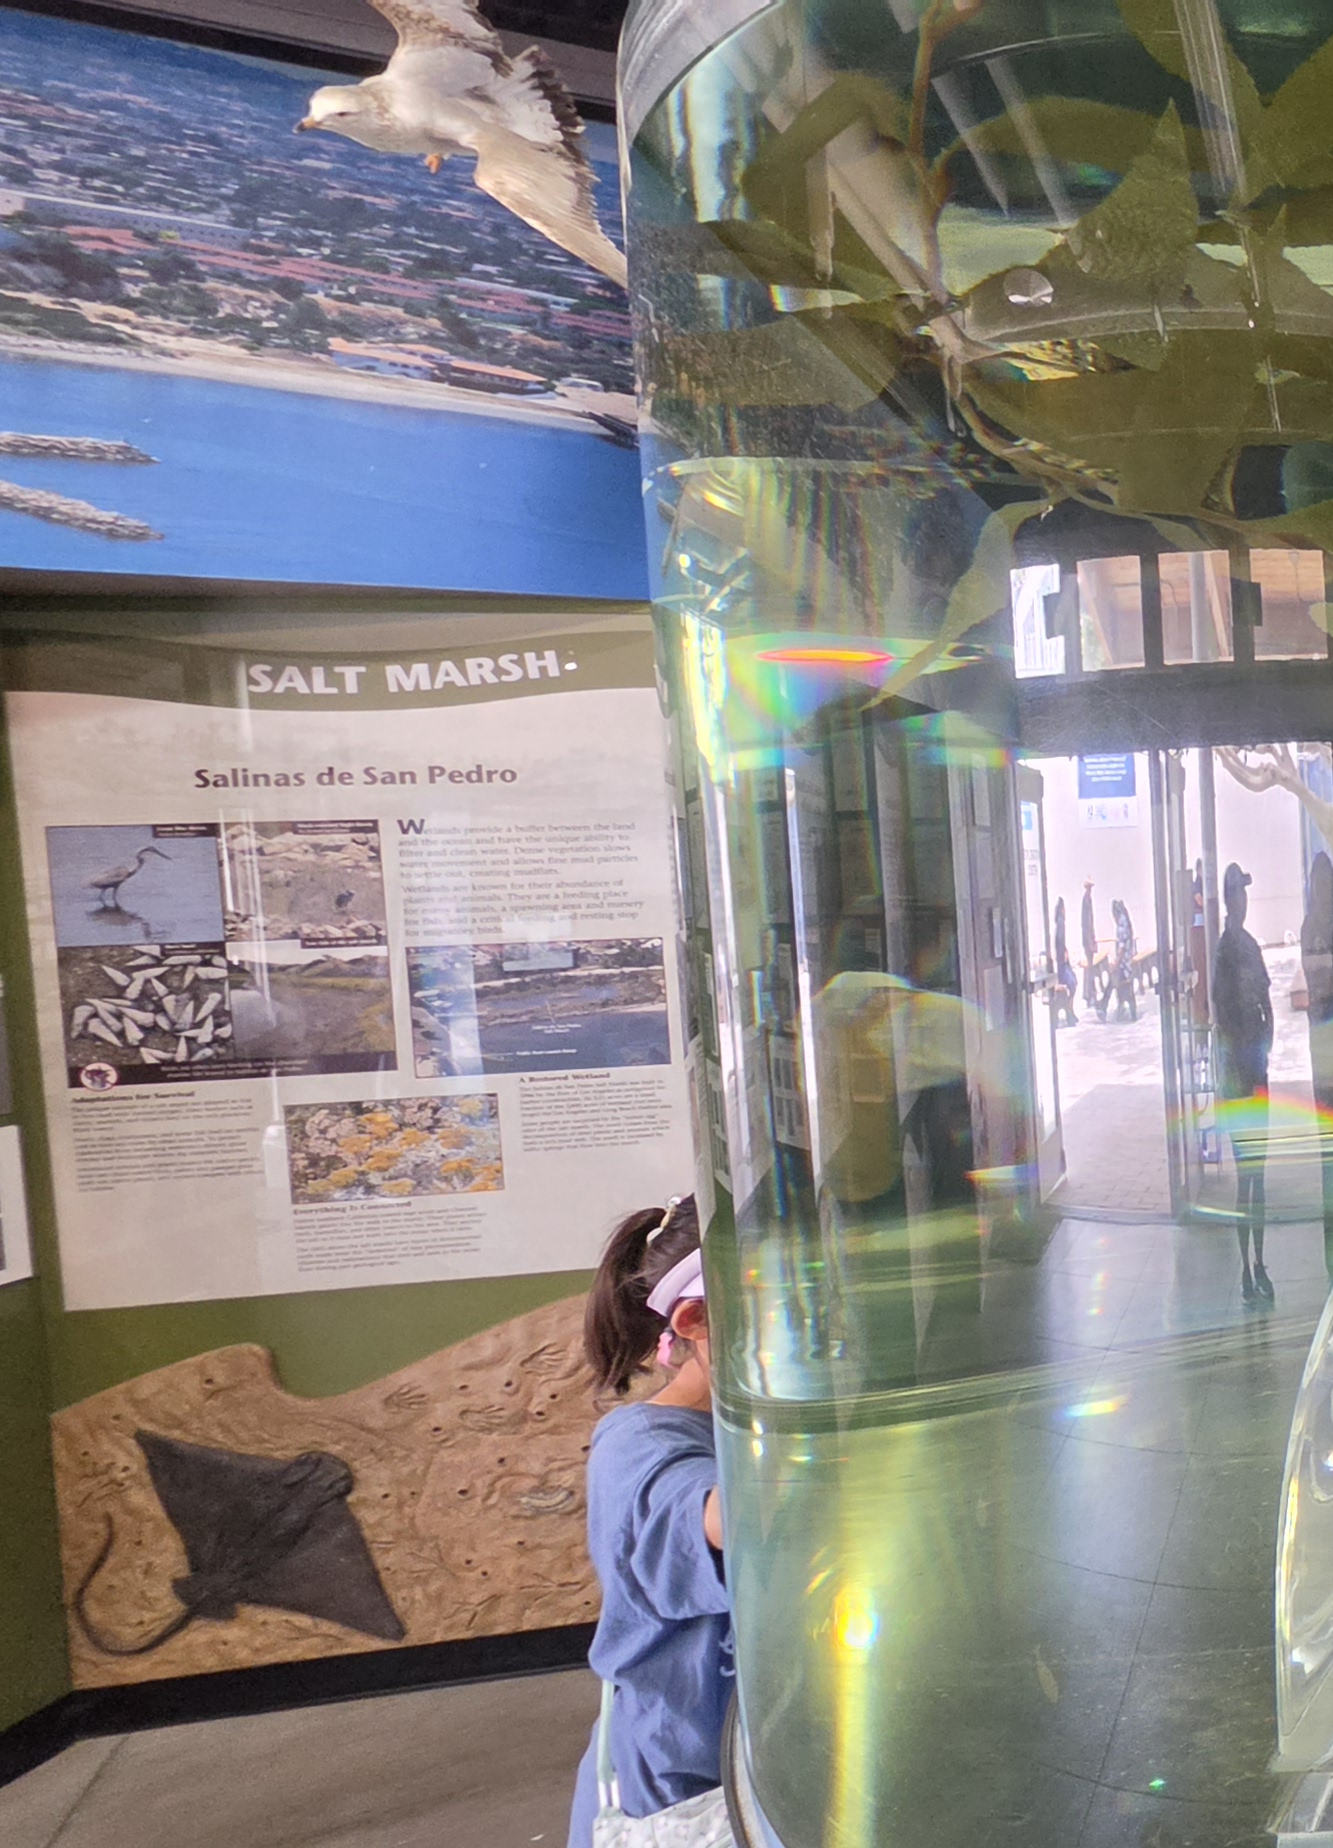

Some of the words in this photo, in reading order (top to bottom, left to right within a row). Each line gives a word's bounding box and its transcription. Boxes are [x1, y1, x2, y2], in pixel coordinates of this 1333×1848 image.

[248, 664, 367, 695] SALT
[385, 650, 561, 693] MARSH
[194, 768, 305, 789] Salinas
[316, 766, 354, 786] de
[363, 765, 418, 787] San
[427, 764, 518, 785] Pedro
